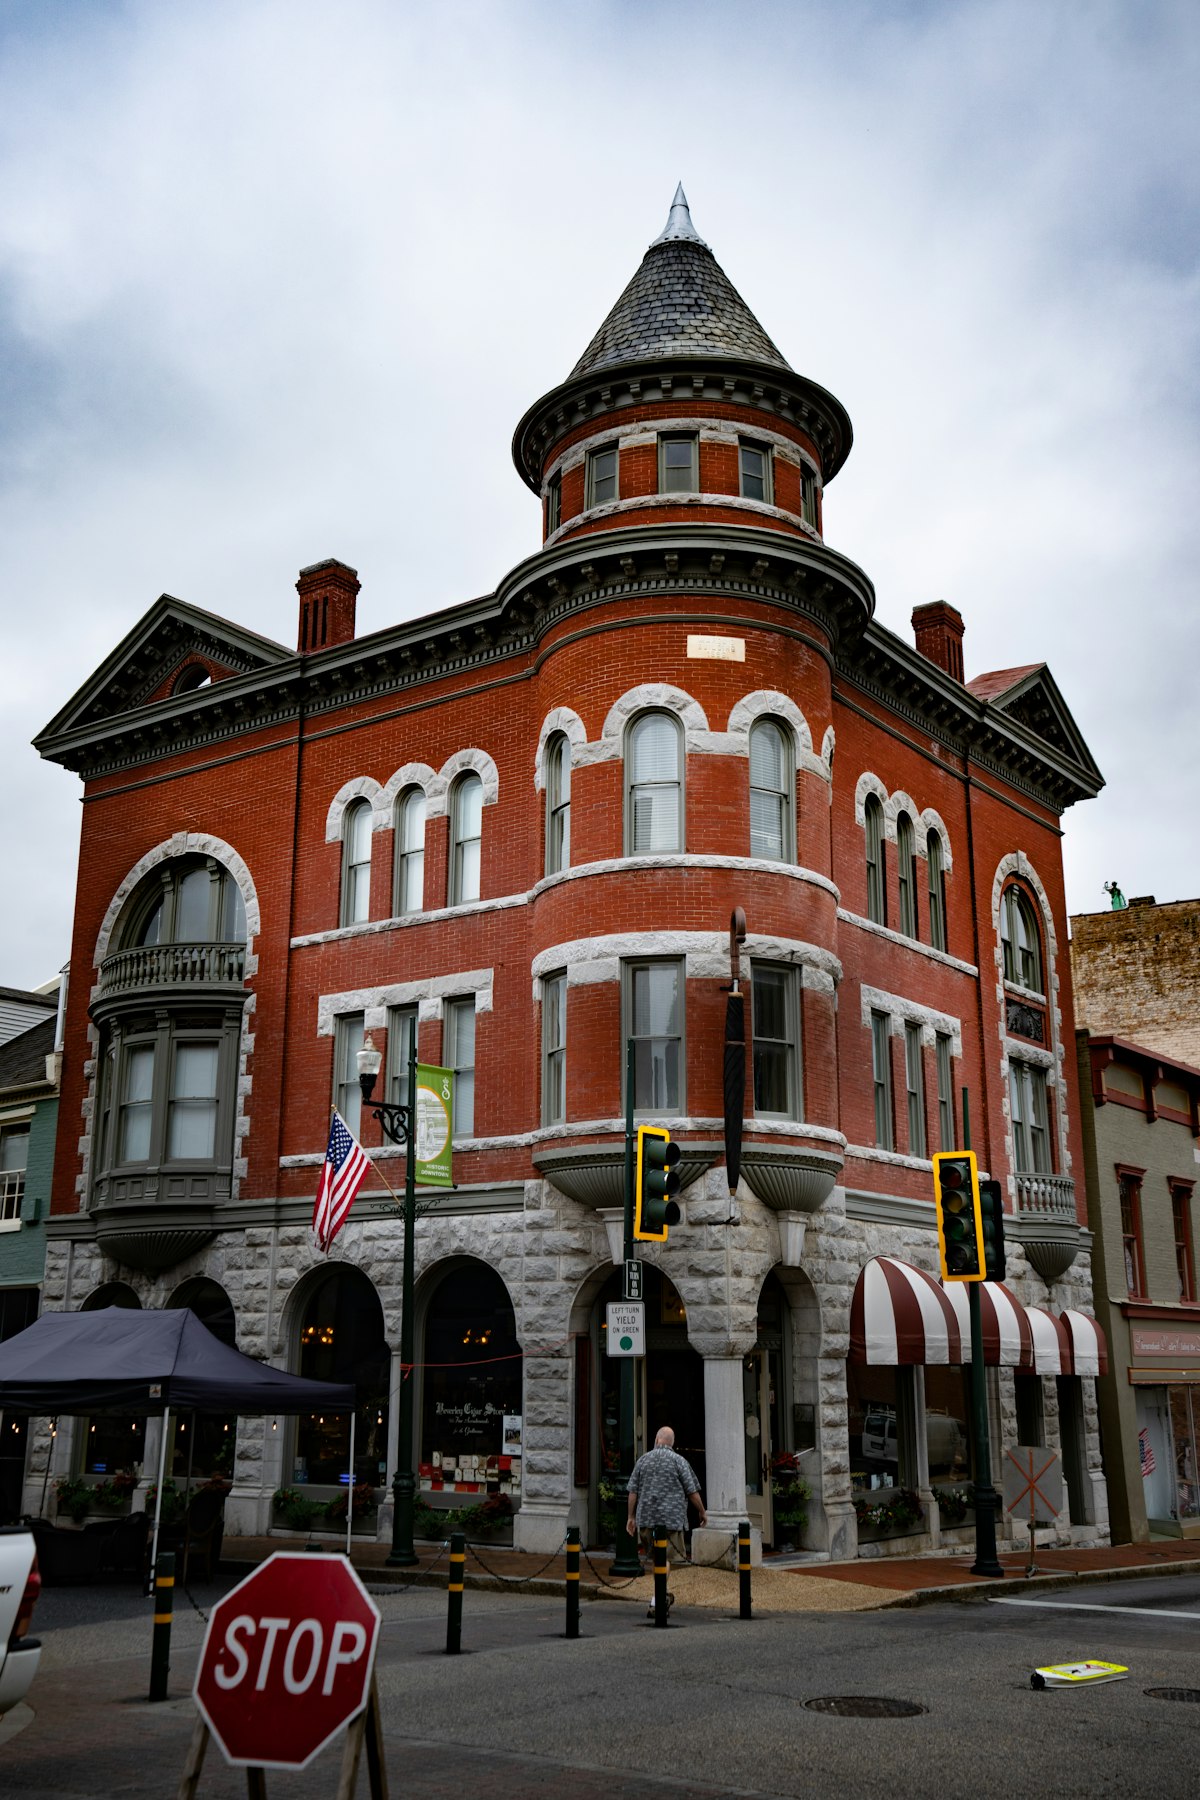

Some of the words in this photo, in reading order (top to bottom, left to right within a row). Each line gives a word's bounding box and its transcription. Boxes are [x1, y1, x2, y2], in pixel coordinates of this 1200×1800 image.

[421, 1169, 449, 1177] DOWNTOWN
[631, 1263, 638, 1271] NO
[629, 1271, 640, 1280] TURN
[630, 1288, 639, 1297] RED
[611, 1306, 624, 1314] LEFT
[625, 1306, 640, 1314] TURN
[616, 1316, 636, 1324] YIELD
[483, 1402, 506, 1416] Store
[214, 1614, 367, 1697] STOP
